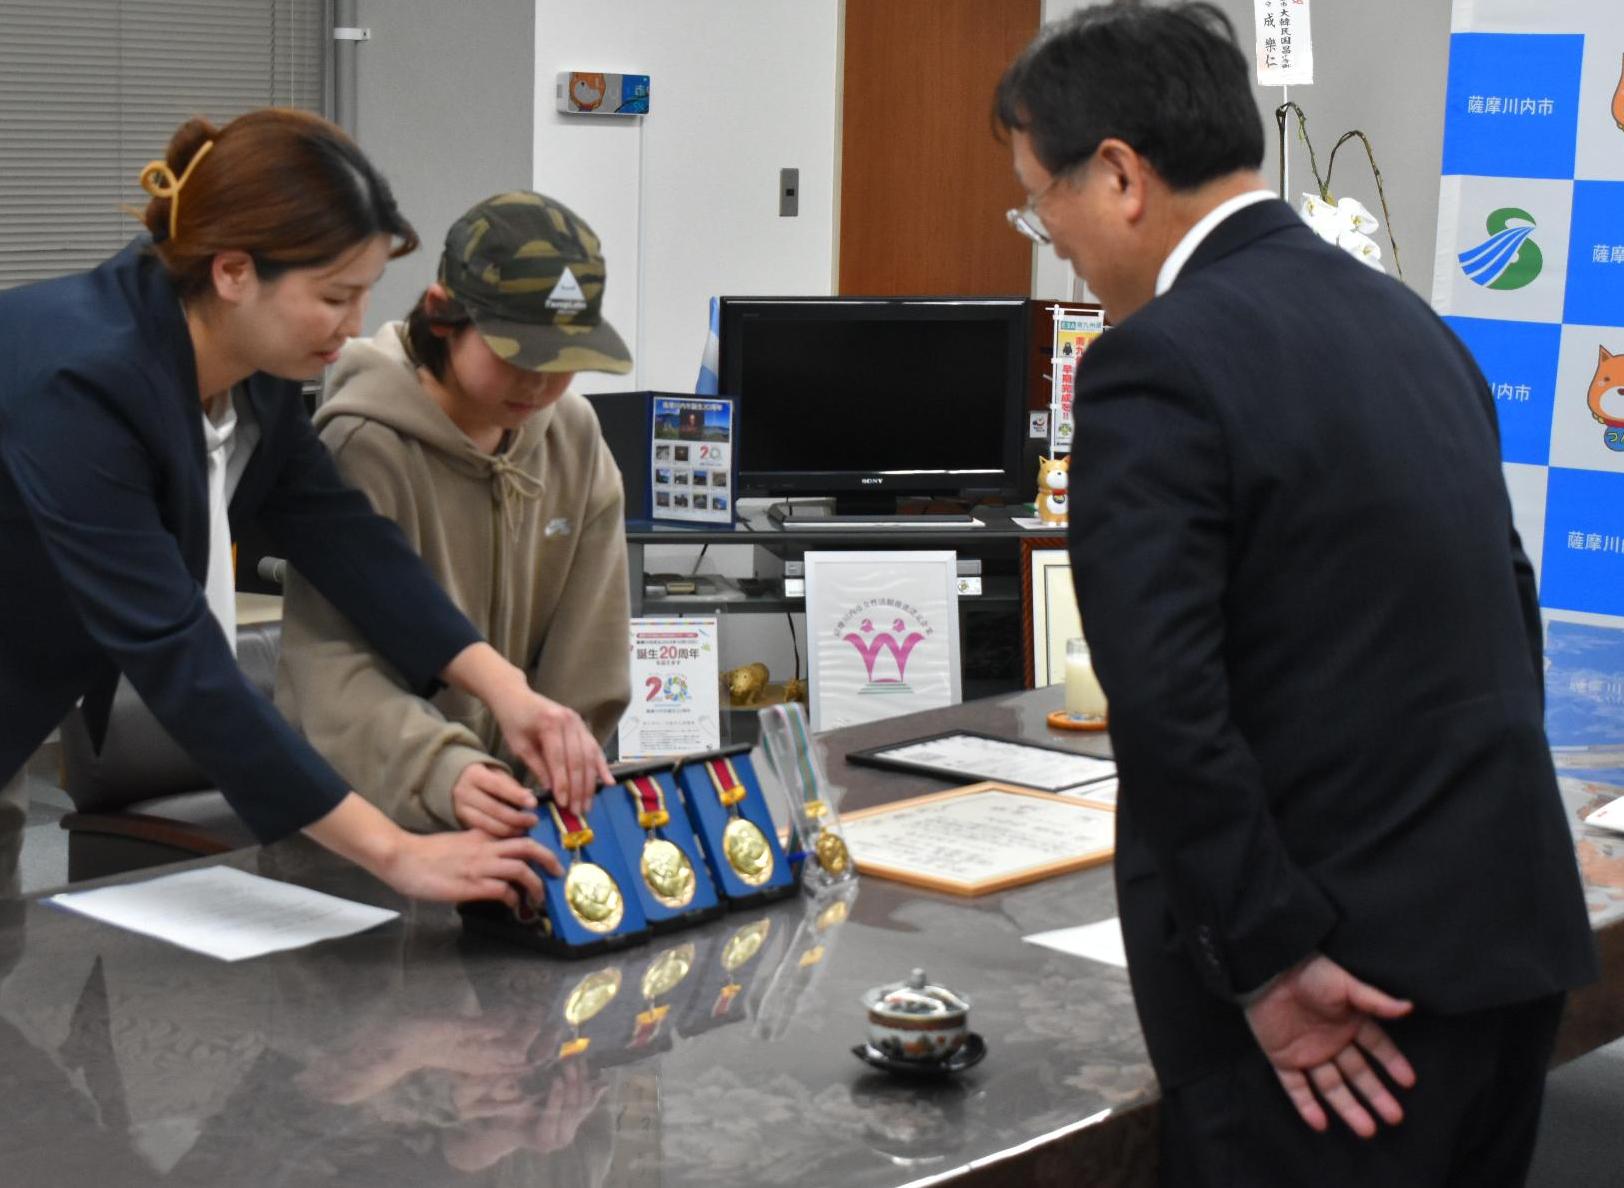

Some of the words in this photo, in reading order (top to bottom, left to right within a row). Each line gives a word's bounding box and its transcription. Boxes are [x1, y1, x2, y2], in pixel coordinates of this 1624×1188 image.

[1468, 95, 1555, 116] 薩摩川内市
[1567, 531, 1624, 553] 薩摩川
